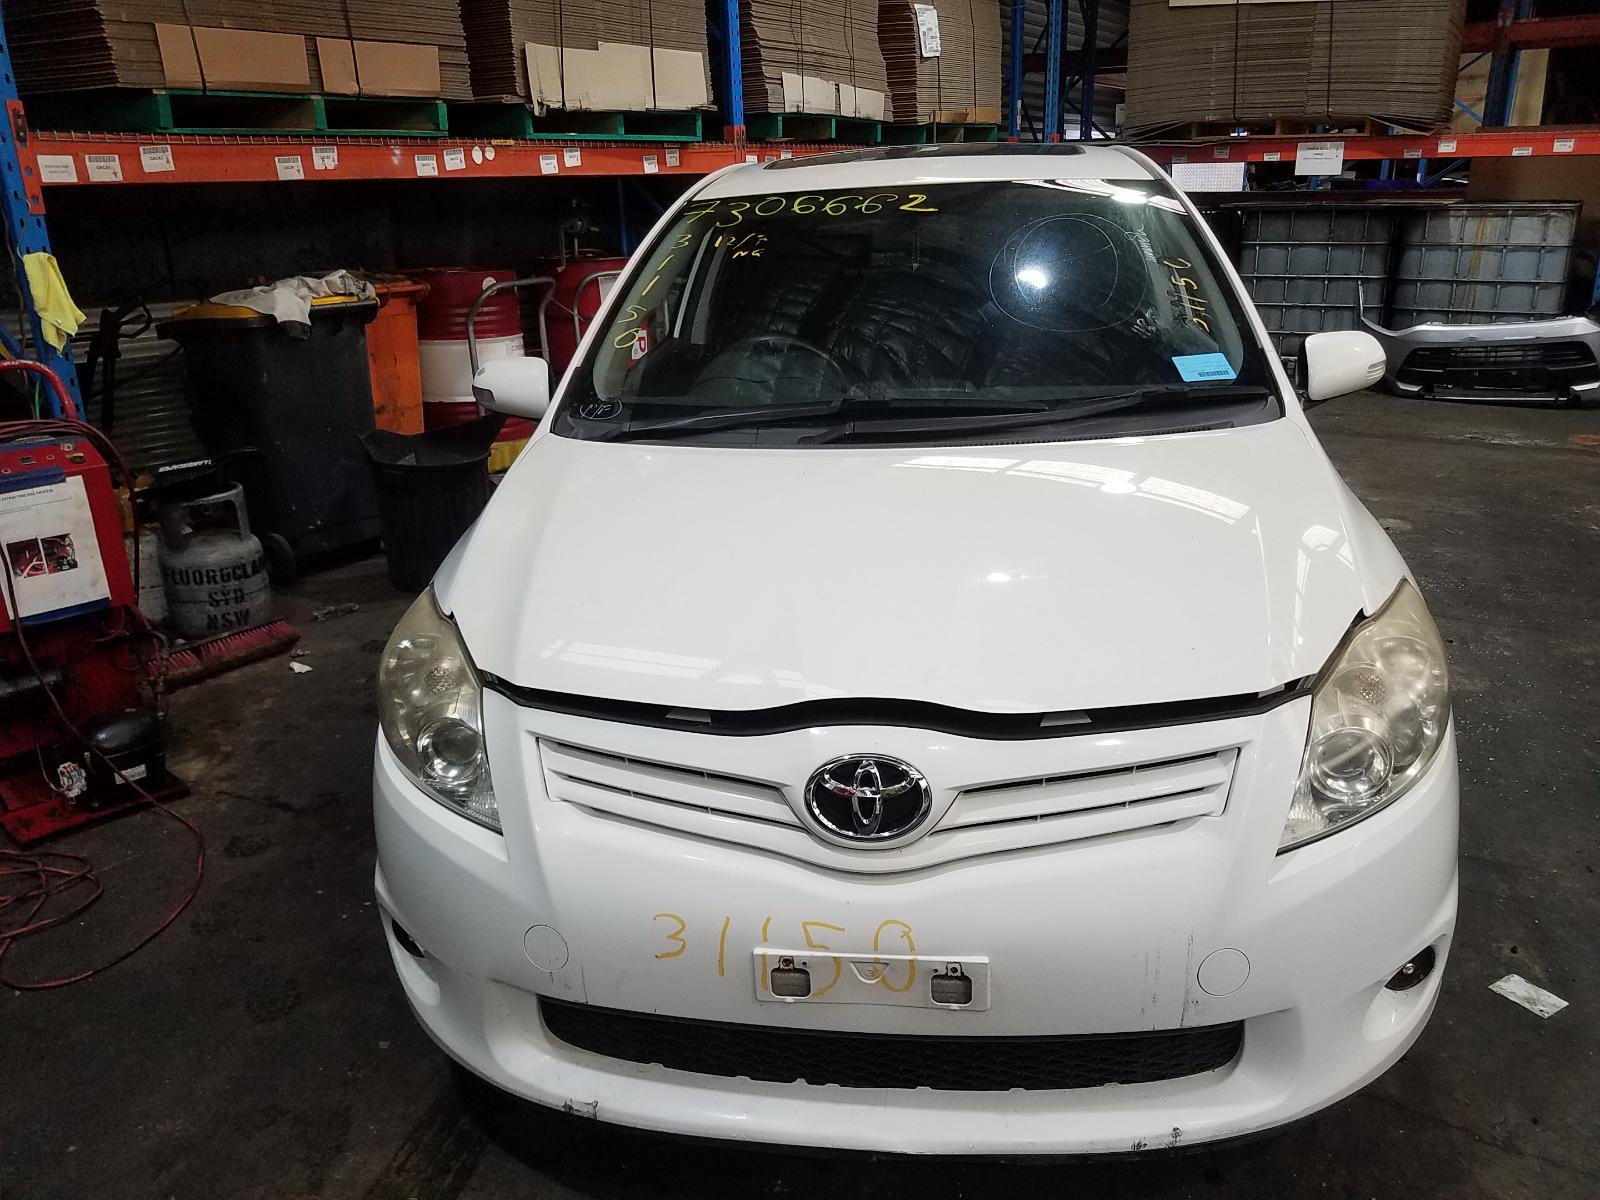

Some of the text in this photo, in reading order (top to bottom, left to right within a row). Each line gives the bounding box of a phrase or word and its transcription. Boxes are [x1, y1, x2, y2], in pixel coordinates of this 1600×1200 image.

[683, 194, 938, 228] 7306662
[207, 588, 245, 608] SYD
[206, 608, 251, 630] NSW
[653, 913, 916, 998] 31150
